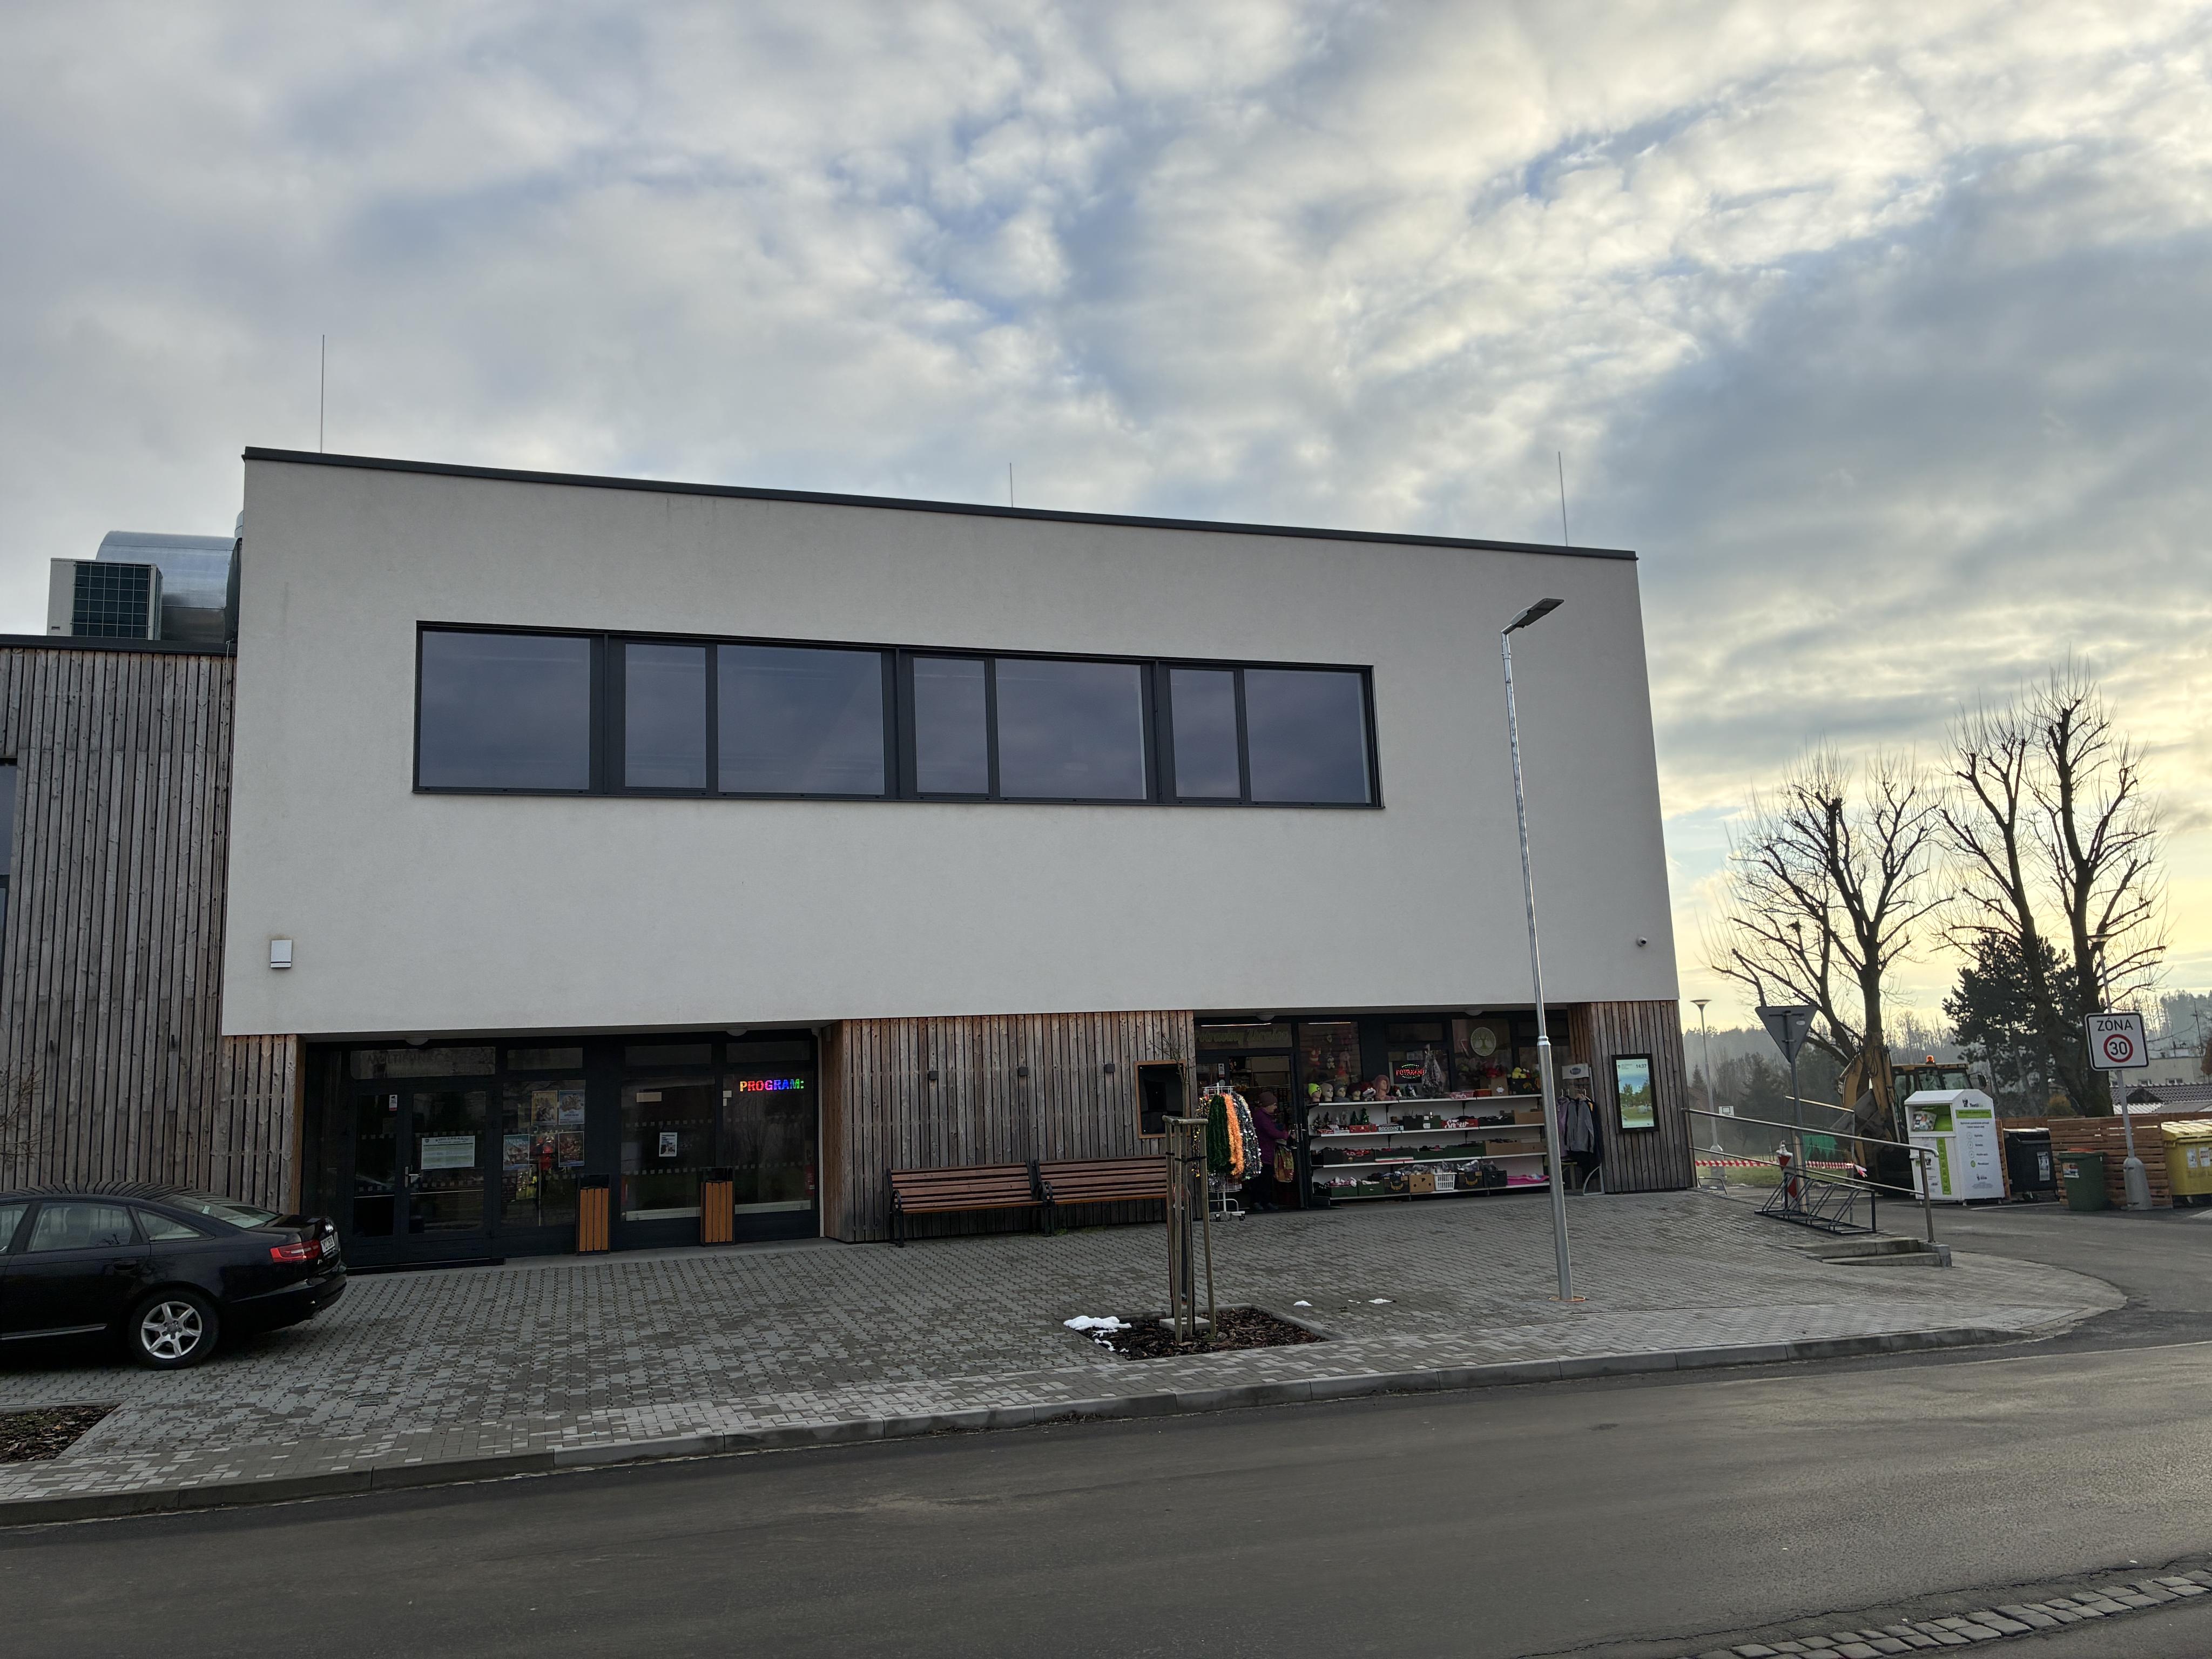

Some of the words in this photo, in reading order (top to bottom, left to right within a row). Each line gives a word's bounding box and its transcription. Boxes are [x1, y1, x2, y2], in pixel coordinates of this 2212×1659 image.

[2096, 1017, 2133, 1031] ZÓNA
[1195, 1029, 1244, 1048] Potraviny
[2109, 1041, 2128, 1056] 30
[739, 1078, 804, 1091] PROGRAM:
